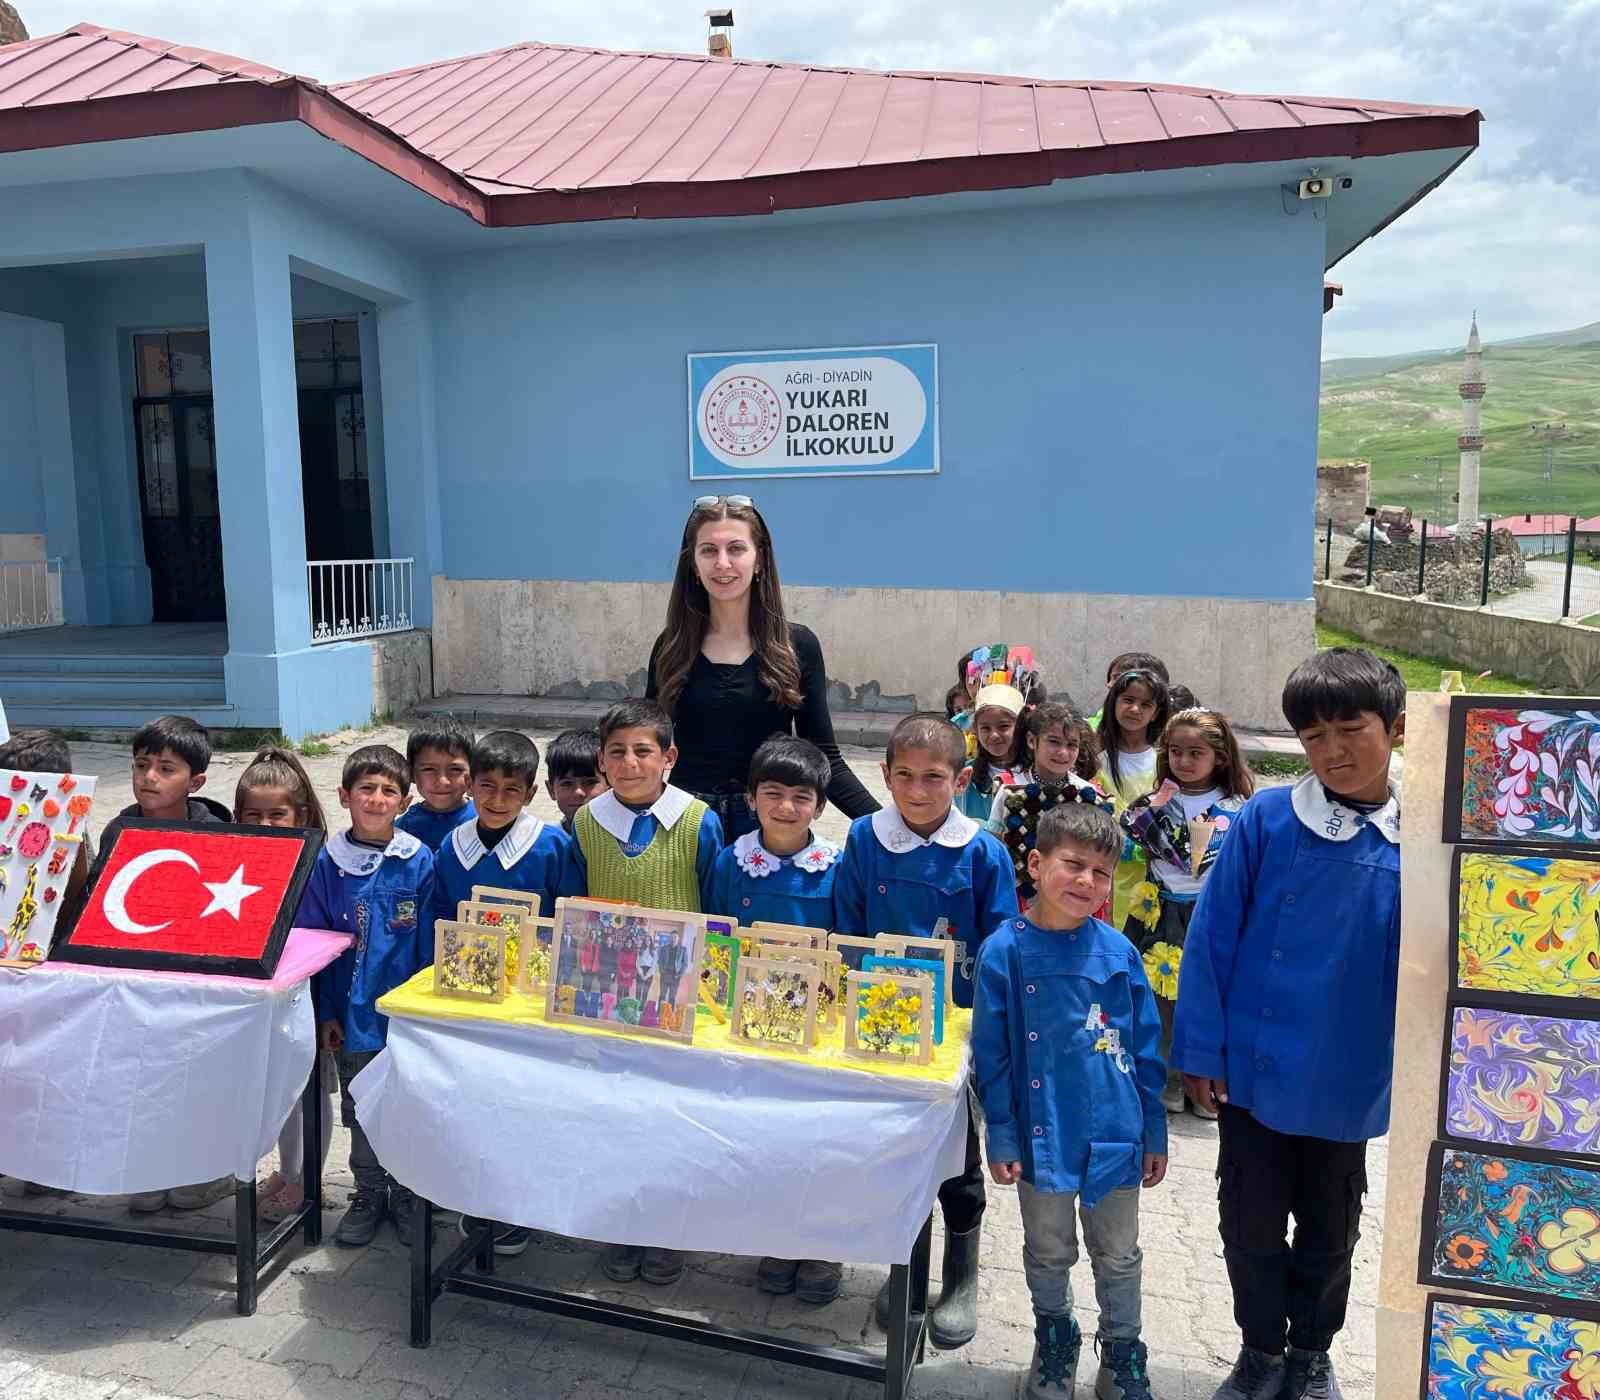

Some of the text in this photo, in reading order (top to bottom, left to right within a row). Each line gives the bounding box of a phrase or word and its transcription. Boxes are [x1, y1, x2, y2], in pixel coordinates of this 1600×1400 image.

[785, 371, 813, 385] AĞRI
[823, 368, 872, 384] DİYADİN
[785, 389, 867, 410] YUKARI
[786, 412, 889, 433] DALOREN
[786, 435, 894, 457] İLKOKULU
[1324, 808, 1345, 837] abc
